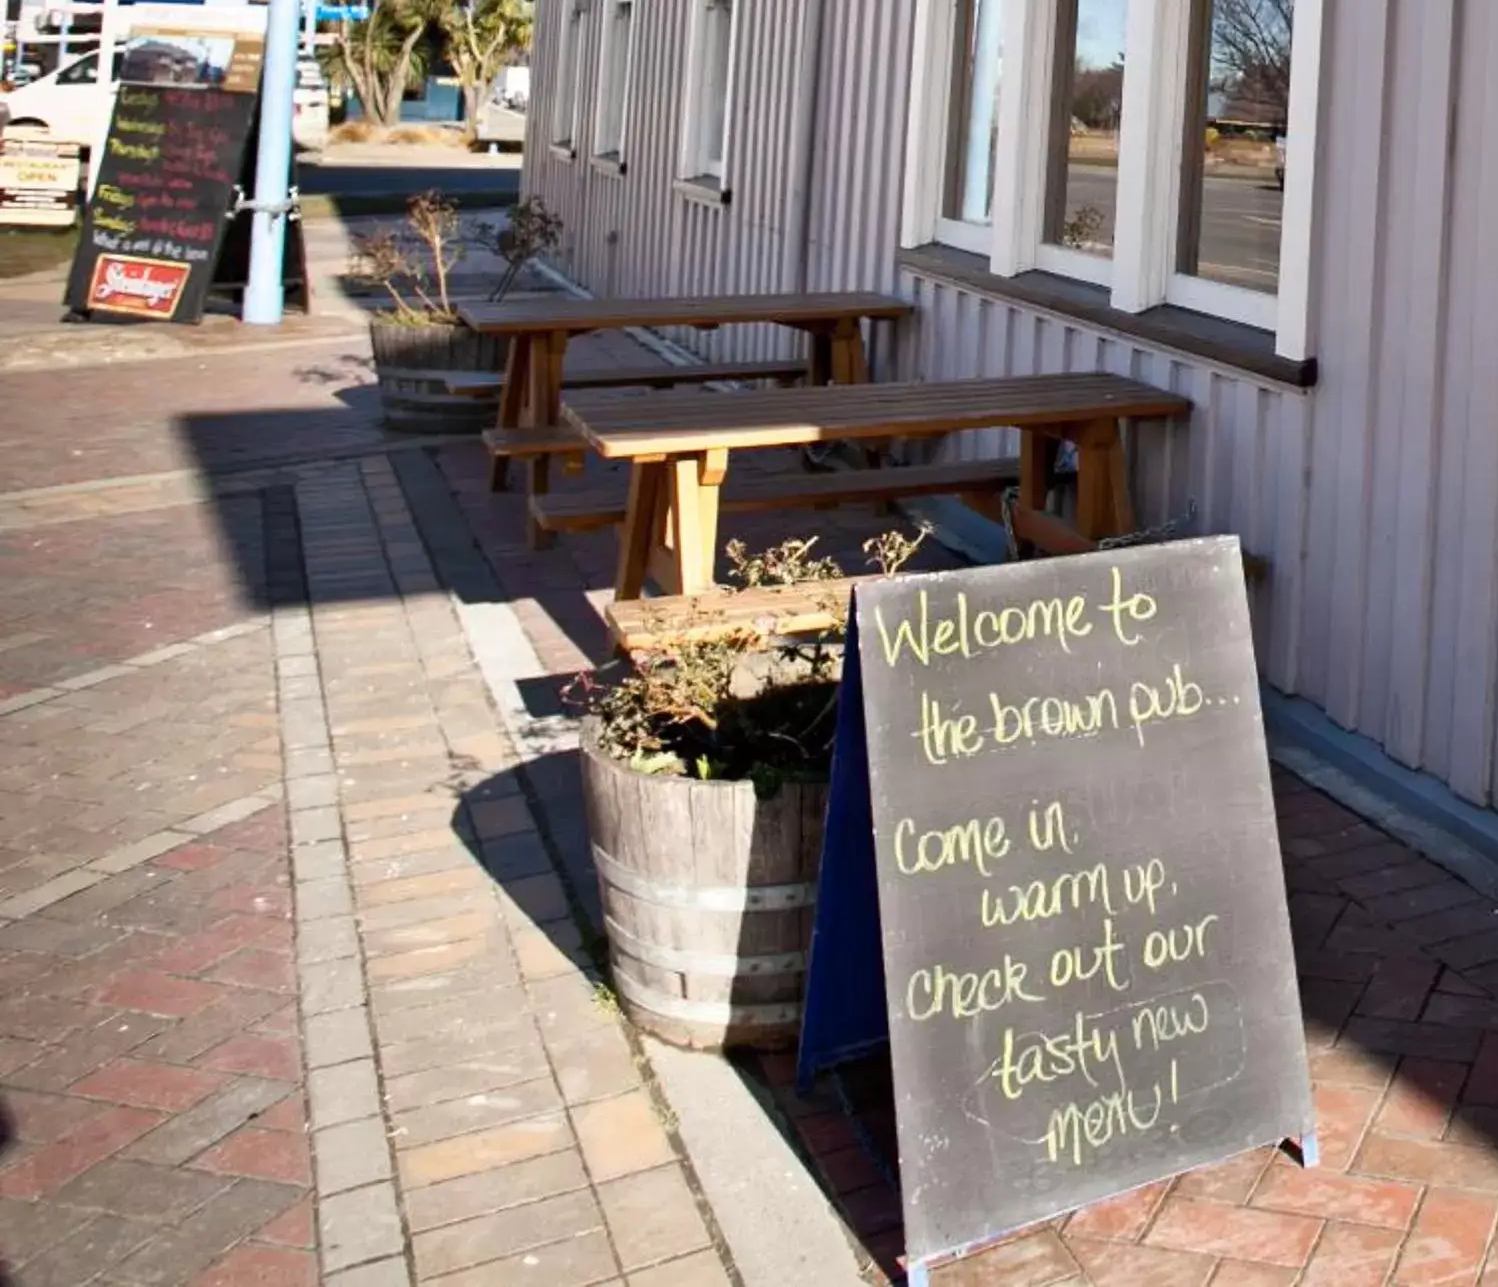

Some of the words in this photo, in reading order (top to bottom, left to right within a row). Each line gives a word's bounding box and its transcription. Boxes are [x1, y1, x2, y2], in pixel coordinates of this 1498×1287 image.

[875, 590, 1092, 667] Welcome
[1098, 566, 1157, 646] to
[912, 689, 983, 764] the
[985, 685, 1119, 745] brown
[981, 863, 1112, 927] warm
[1050, 919, 1130, 990] out
[1144, 915, 1219, 968] our
[992, 1012, 1125, 1107] tasty
[1133, 994, 1209, 1049] new
